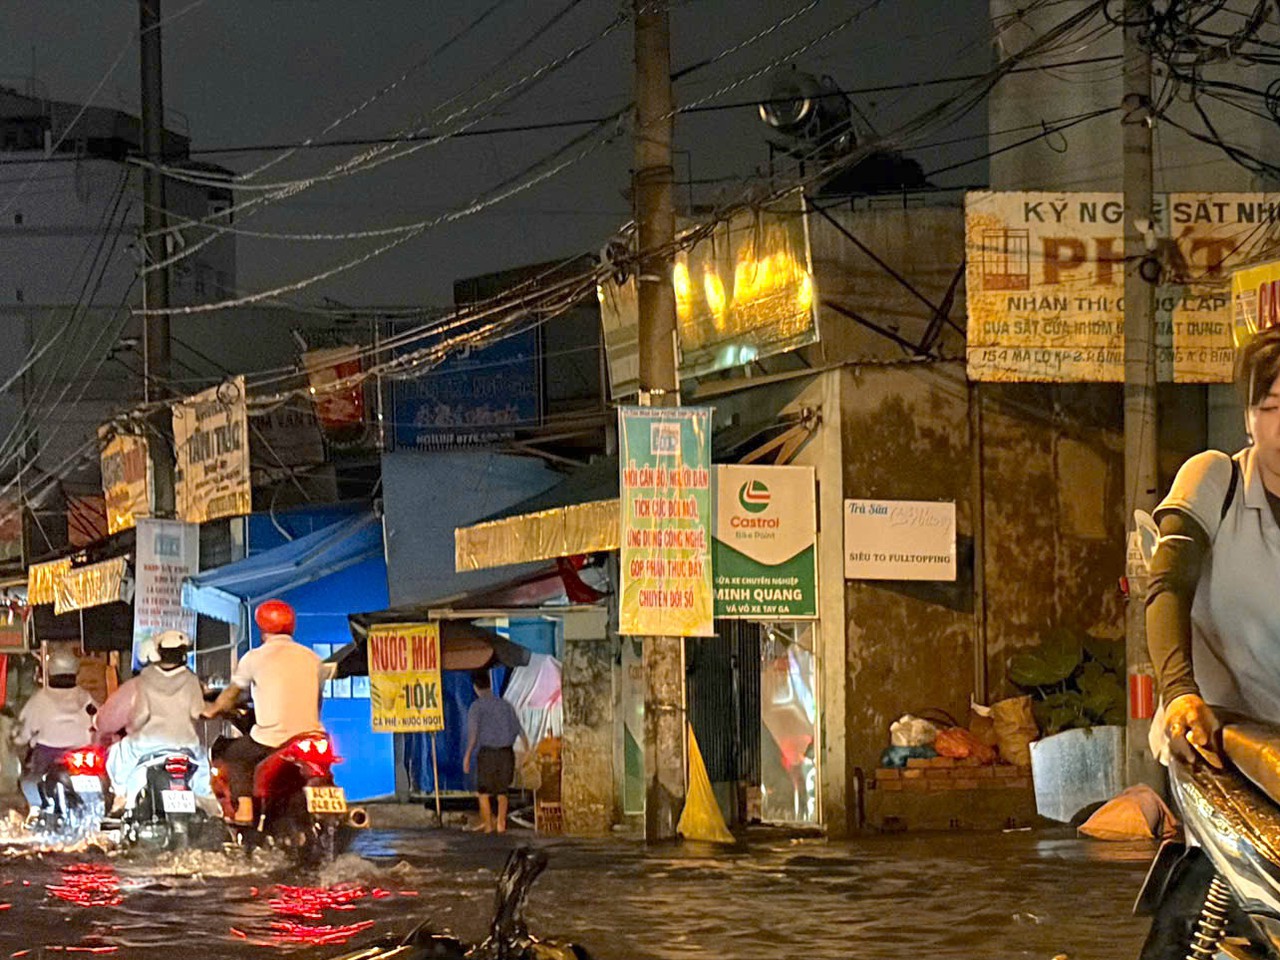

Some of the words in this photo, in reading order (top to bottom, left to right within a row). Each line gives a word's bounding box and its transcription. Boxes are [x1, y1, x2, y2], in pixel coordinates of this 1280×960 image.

[1023, 198, 1068, 224] KỸ
[848, 502, 866, 515] Trà
[730, 515, 780, 530] Castrol
[754, 531, 776, 540] Point
[849, 551, 871, 562] SIÊU
[872, 553, 886, 562] TO
[731, 576, 742, 586] XE
[742, 575, 771, 586] CHUYÊN
[713, 588, 750, 601] MINH
[753, 588, 803, 603] QUANG
[751, 604, 762, 614] XE
[763, 605, 777, 614] TAY
[778, 605, 790, 614] GA
[370, 629, 408, 671] NƯỚC
[411, 629, 438, 671] MÍA
